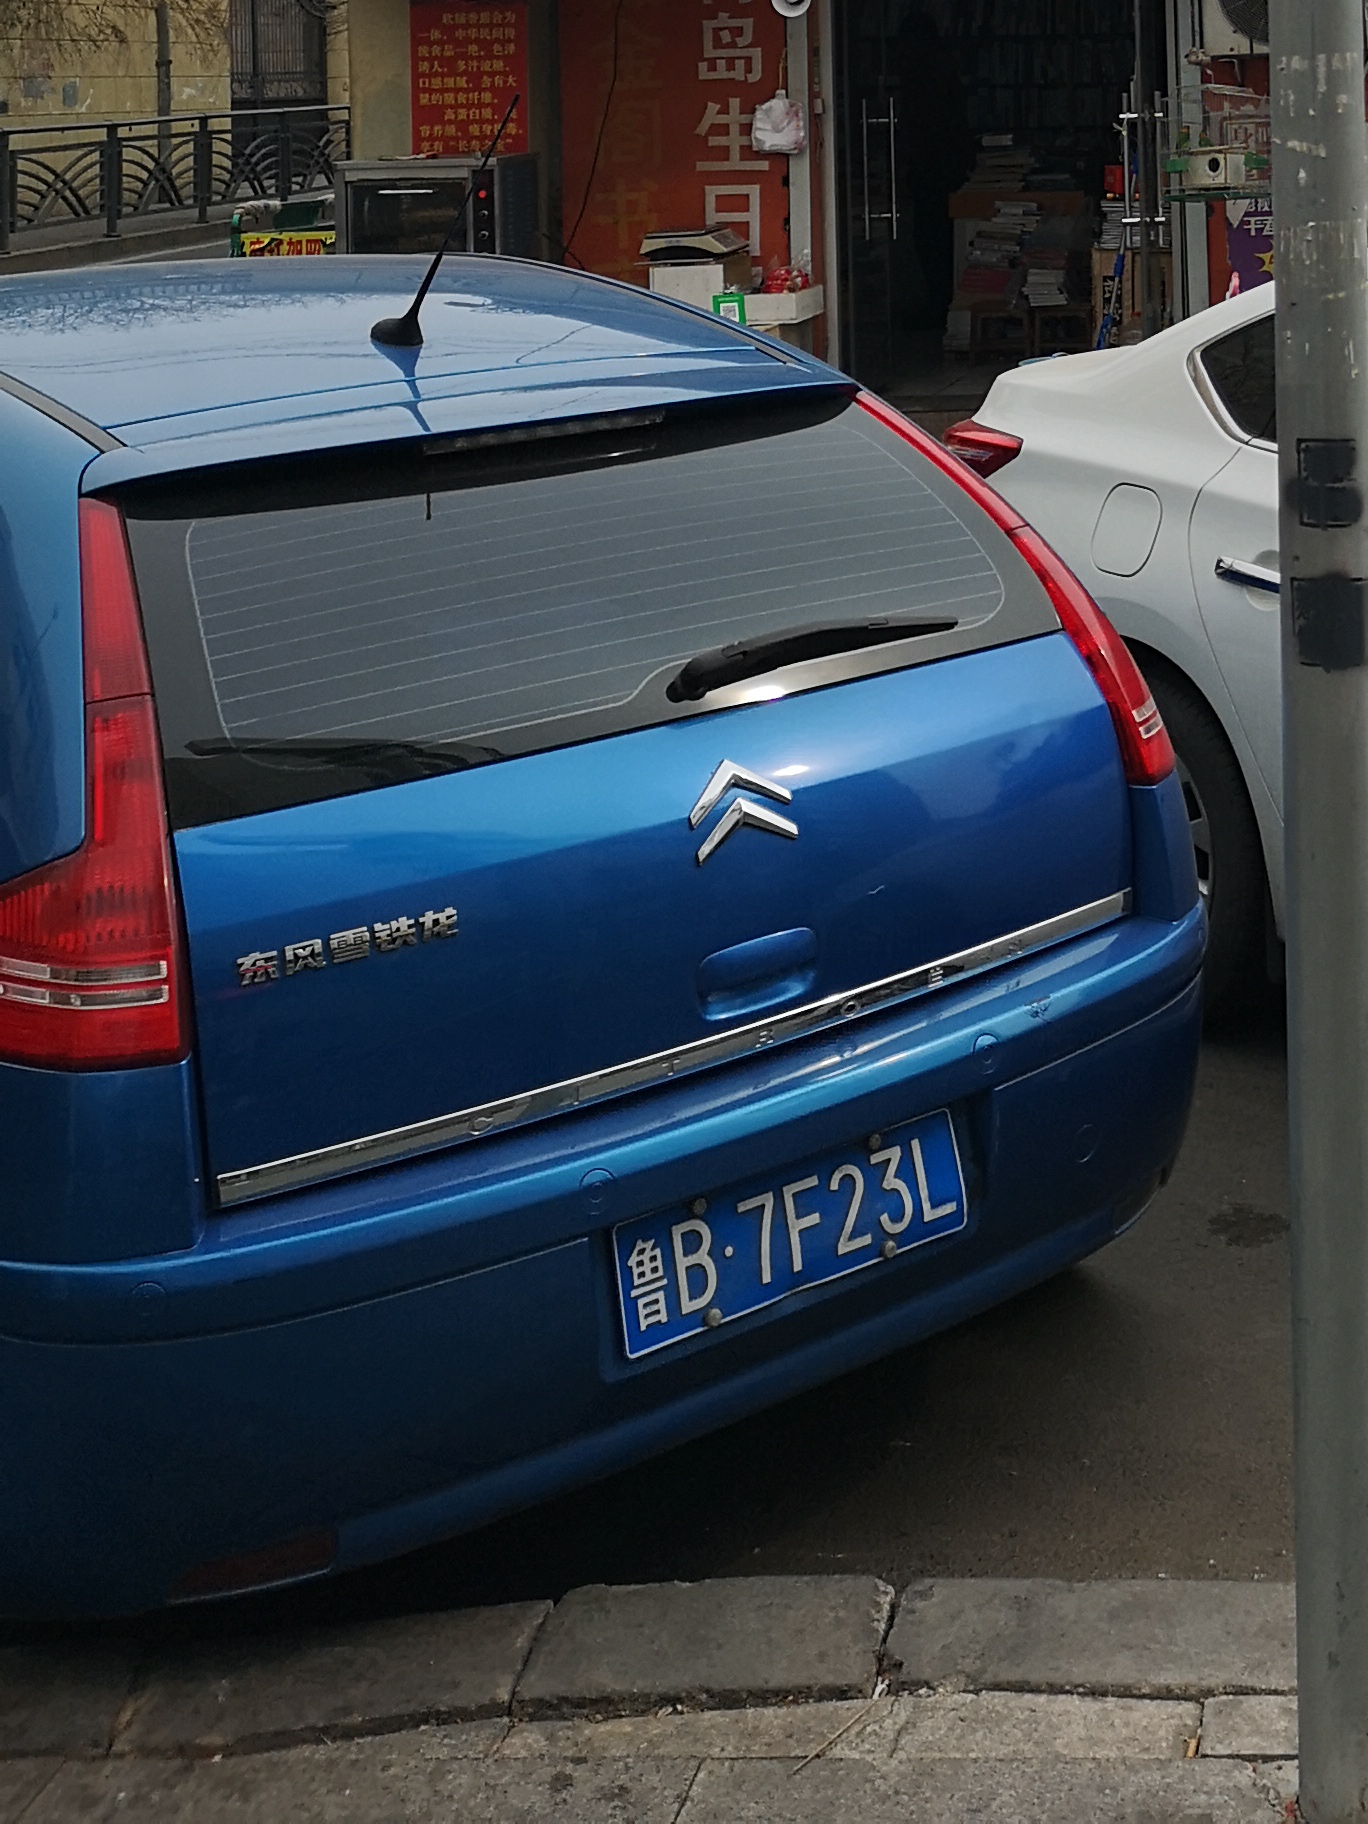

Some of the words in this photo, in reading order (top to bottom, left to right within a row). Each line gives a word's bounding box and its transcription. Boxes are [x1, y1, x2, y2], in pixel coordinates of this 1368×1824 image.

[236, 906, 459, 986] 东风雪铁龙
